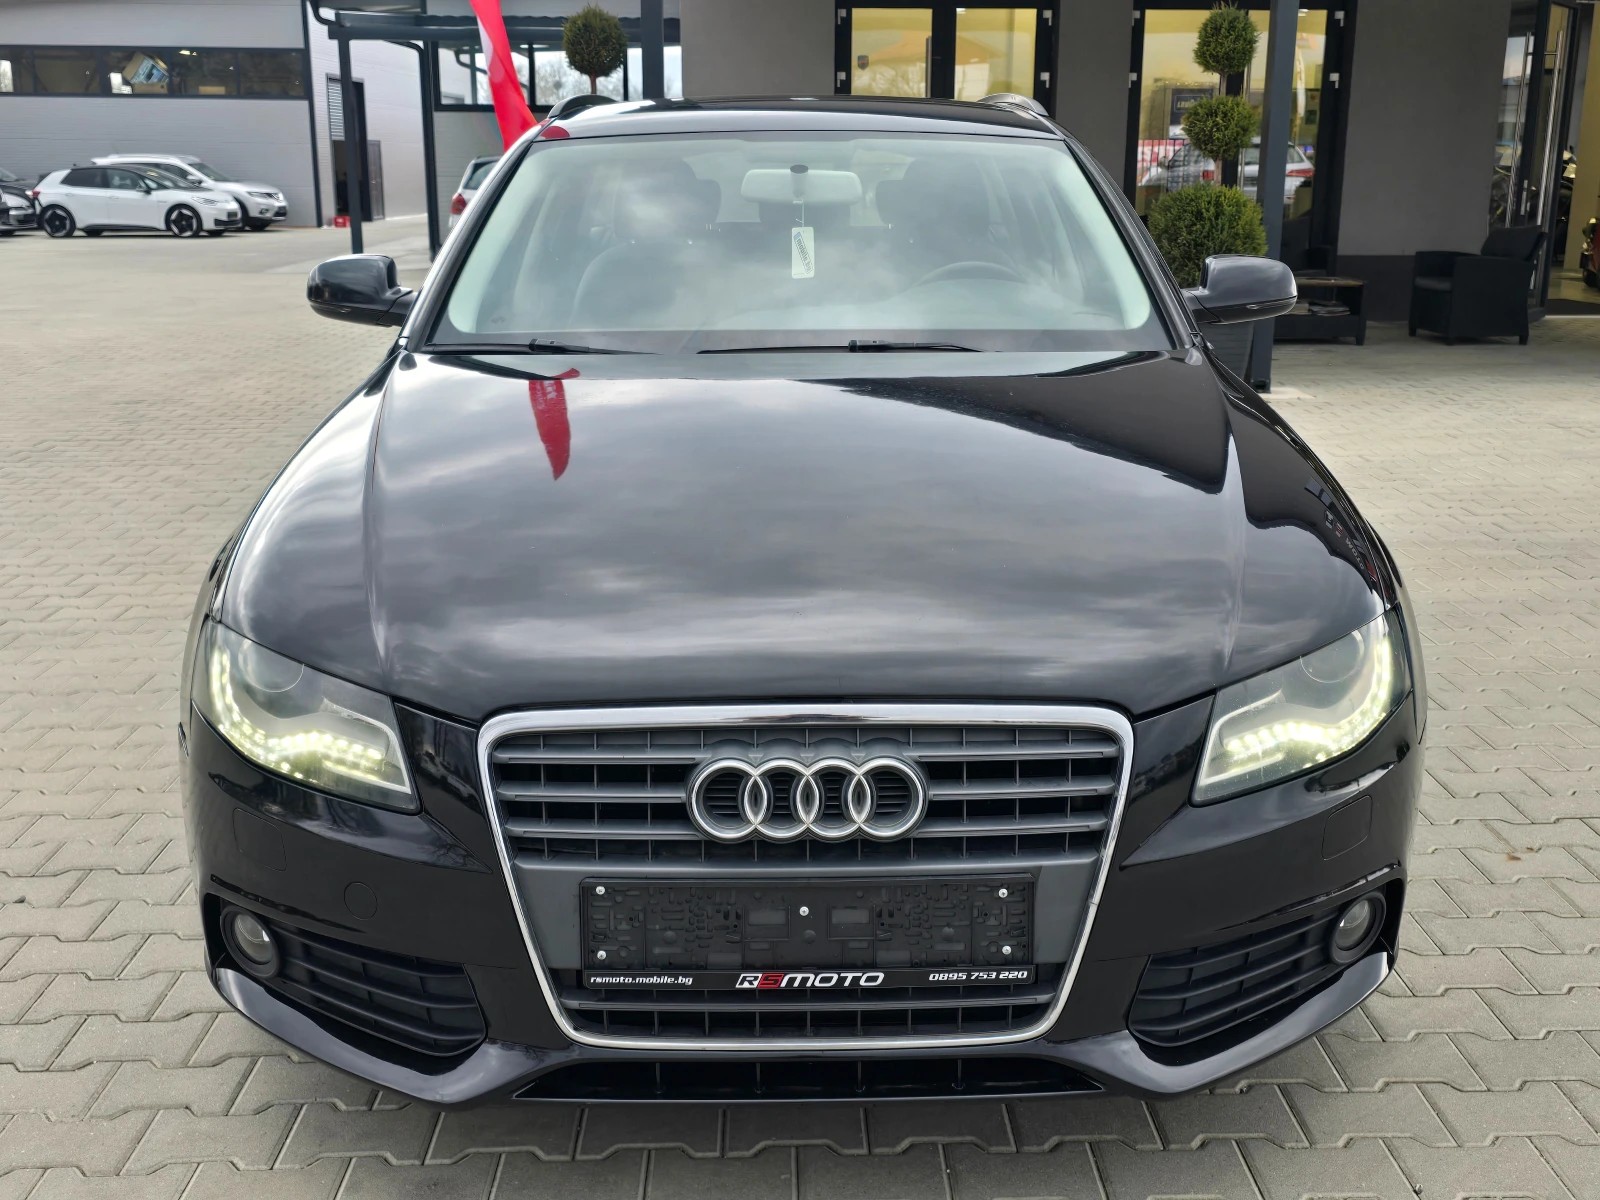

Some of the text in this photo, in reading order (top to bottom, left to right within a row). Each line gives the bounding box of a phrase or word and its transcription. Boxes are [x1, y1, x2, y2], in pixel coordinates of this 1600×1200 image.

[590, 975, 693, 985] rsmoto.mobile.bg
[735, 972, 885, 988] RSMOTO
[928, 971, 1028, 981] 0895 753 220
